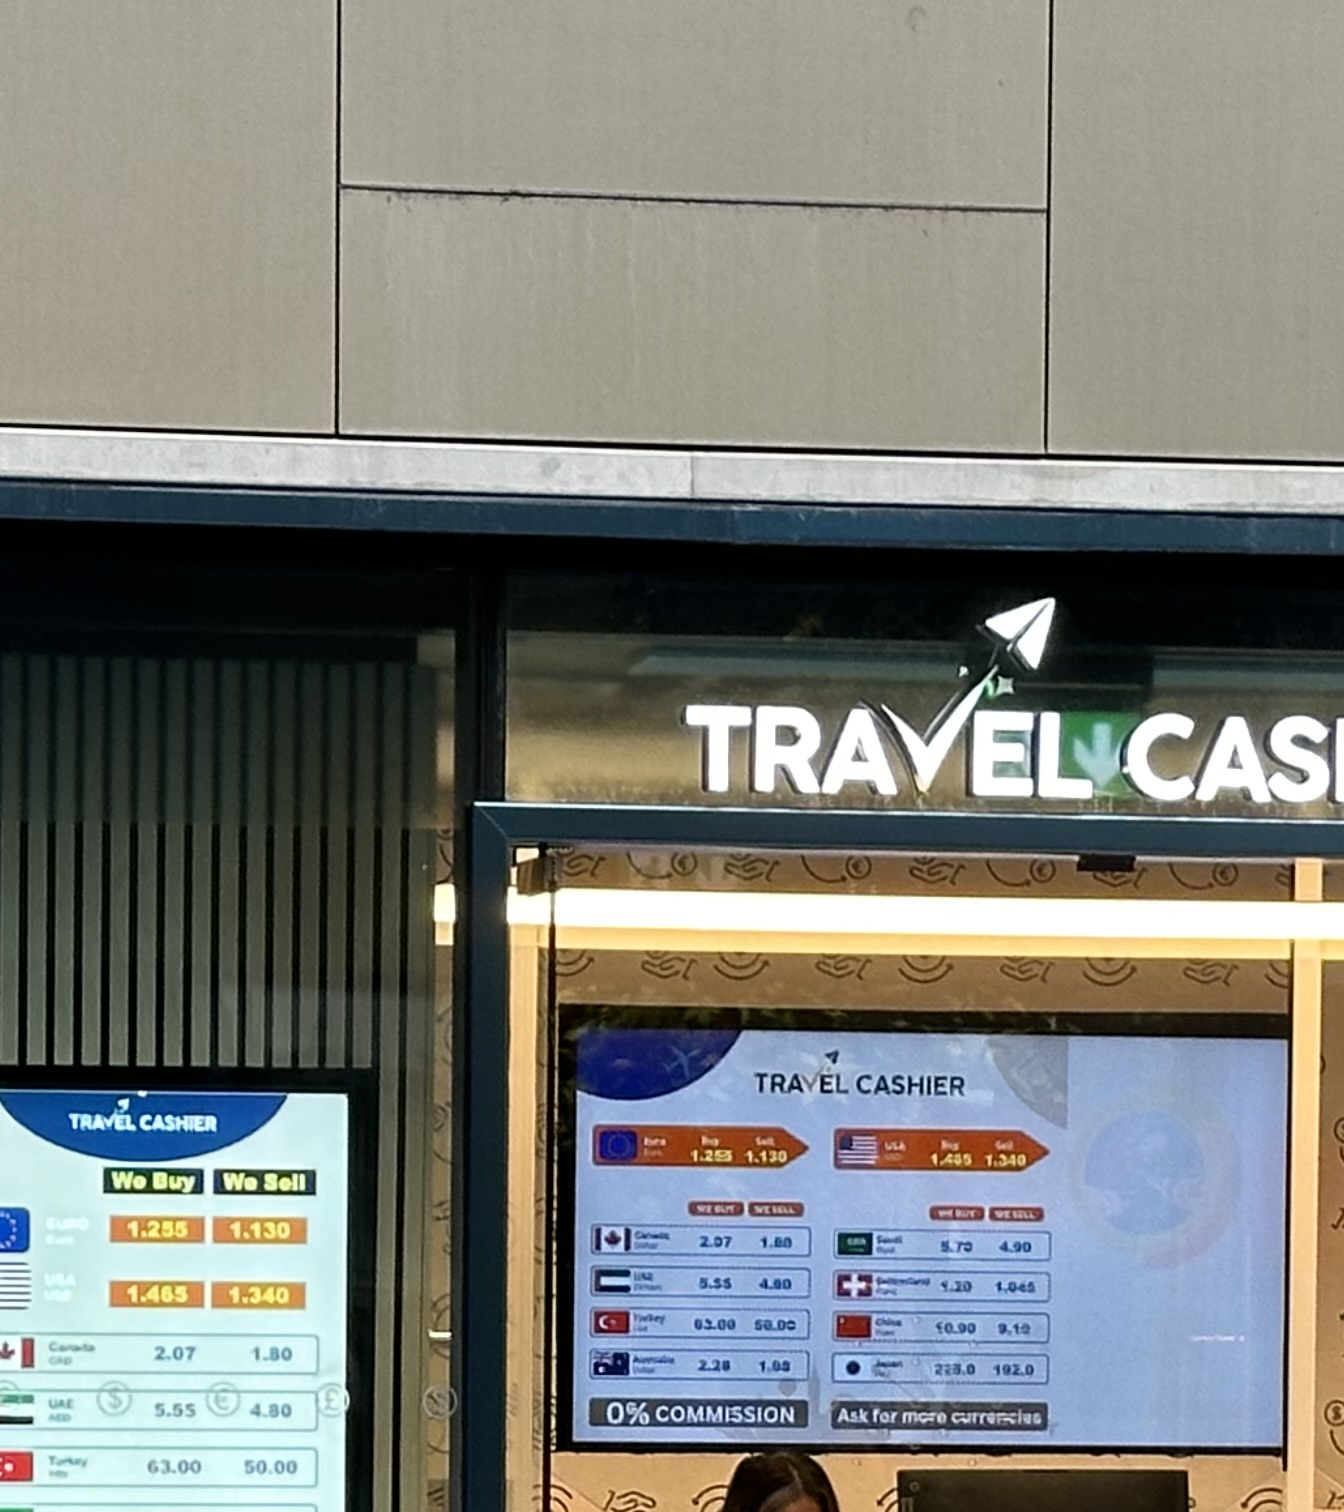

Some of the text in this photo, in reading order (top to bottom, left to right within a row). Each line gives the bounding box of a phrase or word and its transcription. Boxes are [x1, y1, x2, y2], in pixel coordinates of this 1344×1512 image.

[684, 668, 1094, 800] TRAVEL
[753, 1072, 966, 1097] TRAVEL CASHIER
[68, 1111, 218, 1132] TRAVEL CASHIER
[110, 1171, 196, 1194] We Buy
[222, 1173, 306, 1191] We Sell
[127, 1221, 189, 1238] 1.255
[229, 1222, 291, 1239] 1.130
[699, 1236, 733, 1248] 2.07
[127, 1286, 189, 1303] 1.465
[228, 1286, 290, 1304] 1.340
[154, 1346, 197, 1361] 2.07
[252, 1346, 293, 1362] 1.80
[48, 1398, 74, 1409] UAE
[154, 1402, 197, 1418] 5.55
[249, 1402, 293, 1419] 4.80
[606, 1402, 796, 1425] 0% COMMISSION
[837, 1408, 1042, 1426] Ask for more currencies
[147, 1459, 202, 1475] 63.00
[243, 1459, 298, 1475] 50.00
